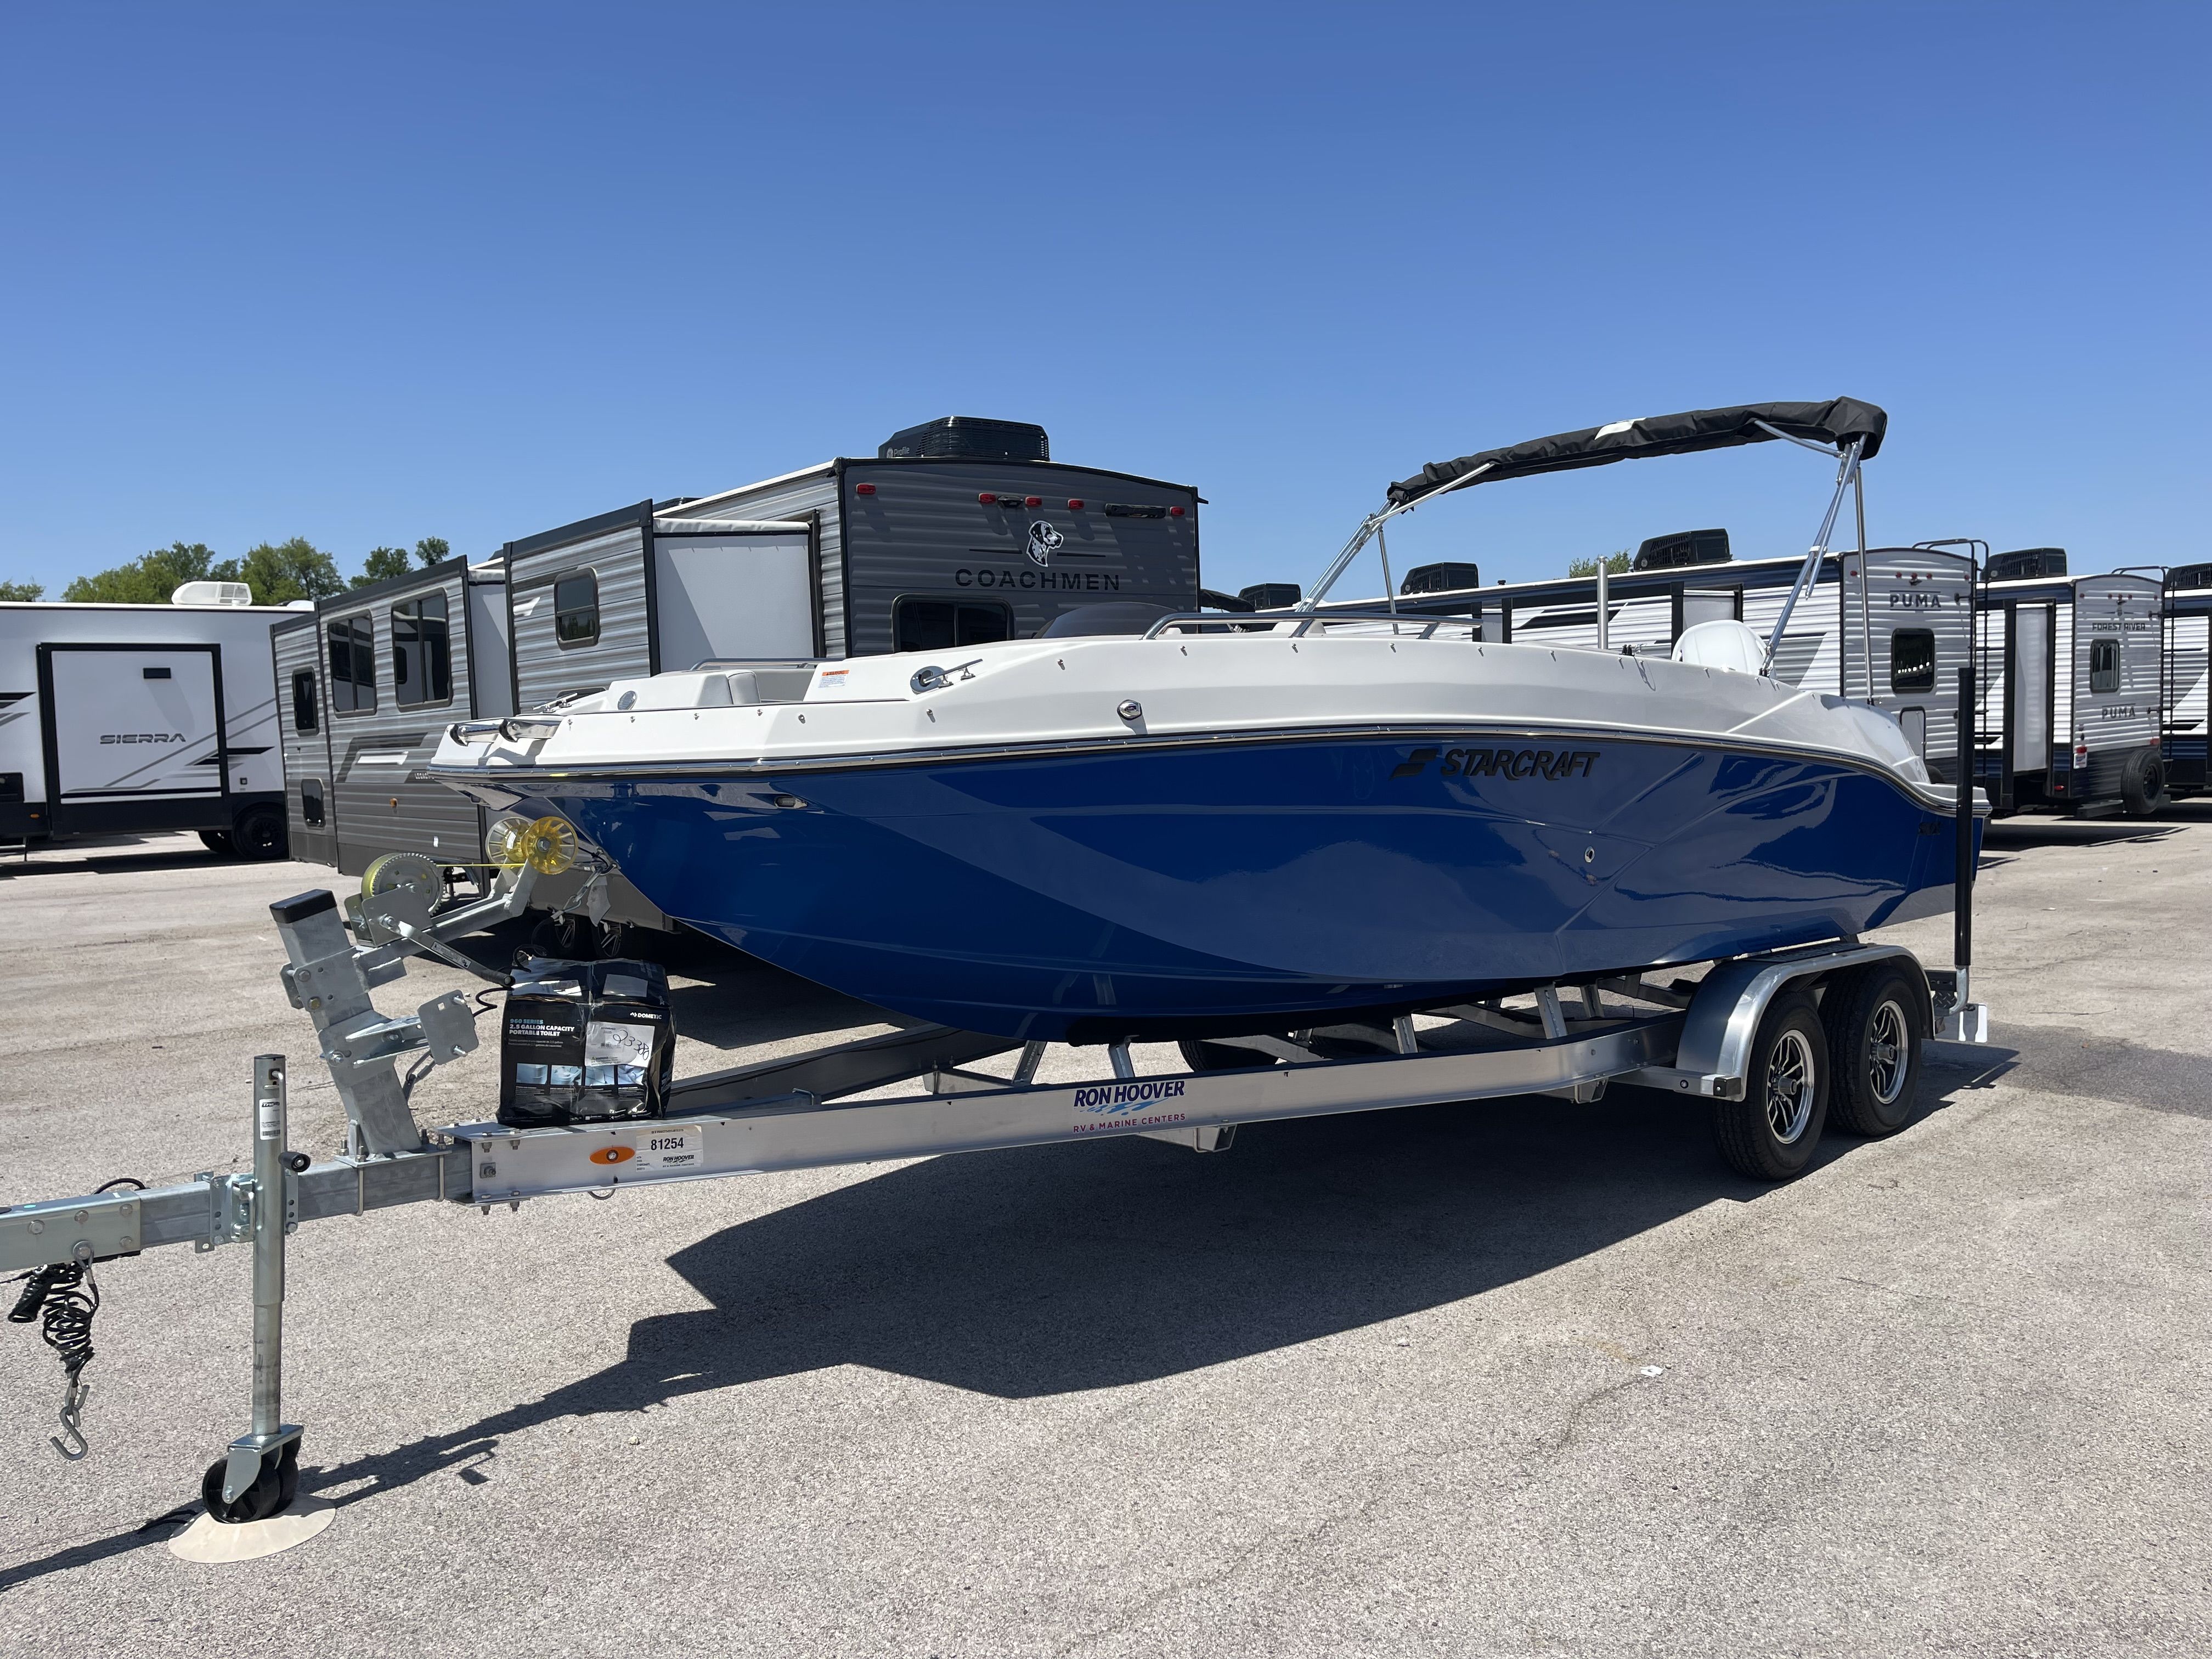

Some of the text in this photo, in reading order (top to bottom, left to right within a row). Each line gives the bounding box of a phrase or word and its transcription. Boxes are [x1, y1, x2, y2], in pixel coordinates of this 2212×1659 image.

[894, 446, 910, 457] Profile
[955, 568, 1120, 591] COACHMEN
[1889, 594, 1942, 608] PUMA
[2092, 622, 2146, 631] FOREST RIVER
[2101, 705, 2136, 720] PUMA
[99, 732, 187, 744] SIERRA
[1440, 748, 1601, 781] STARCRAFT
[1074, 1080, 1185, 1107] RON HOOVER
[1073, 1125, 1086, 1133] RV
[1099, 1119, 1137, 1130] MARINE
[1141, 1113, 1186, 1125] CENTERS
[650, 1137, 684, 1150] 81254
